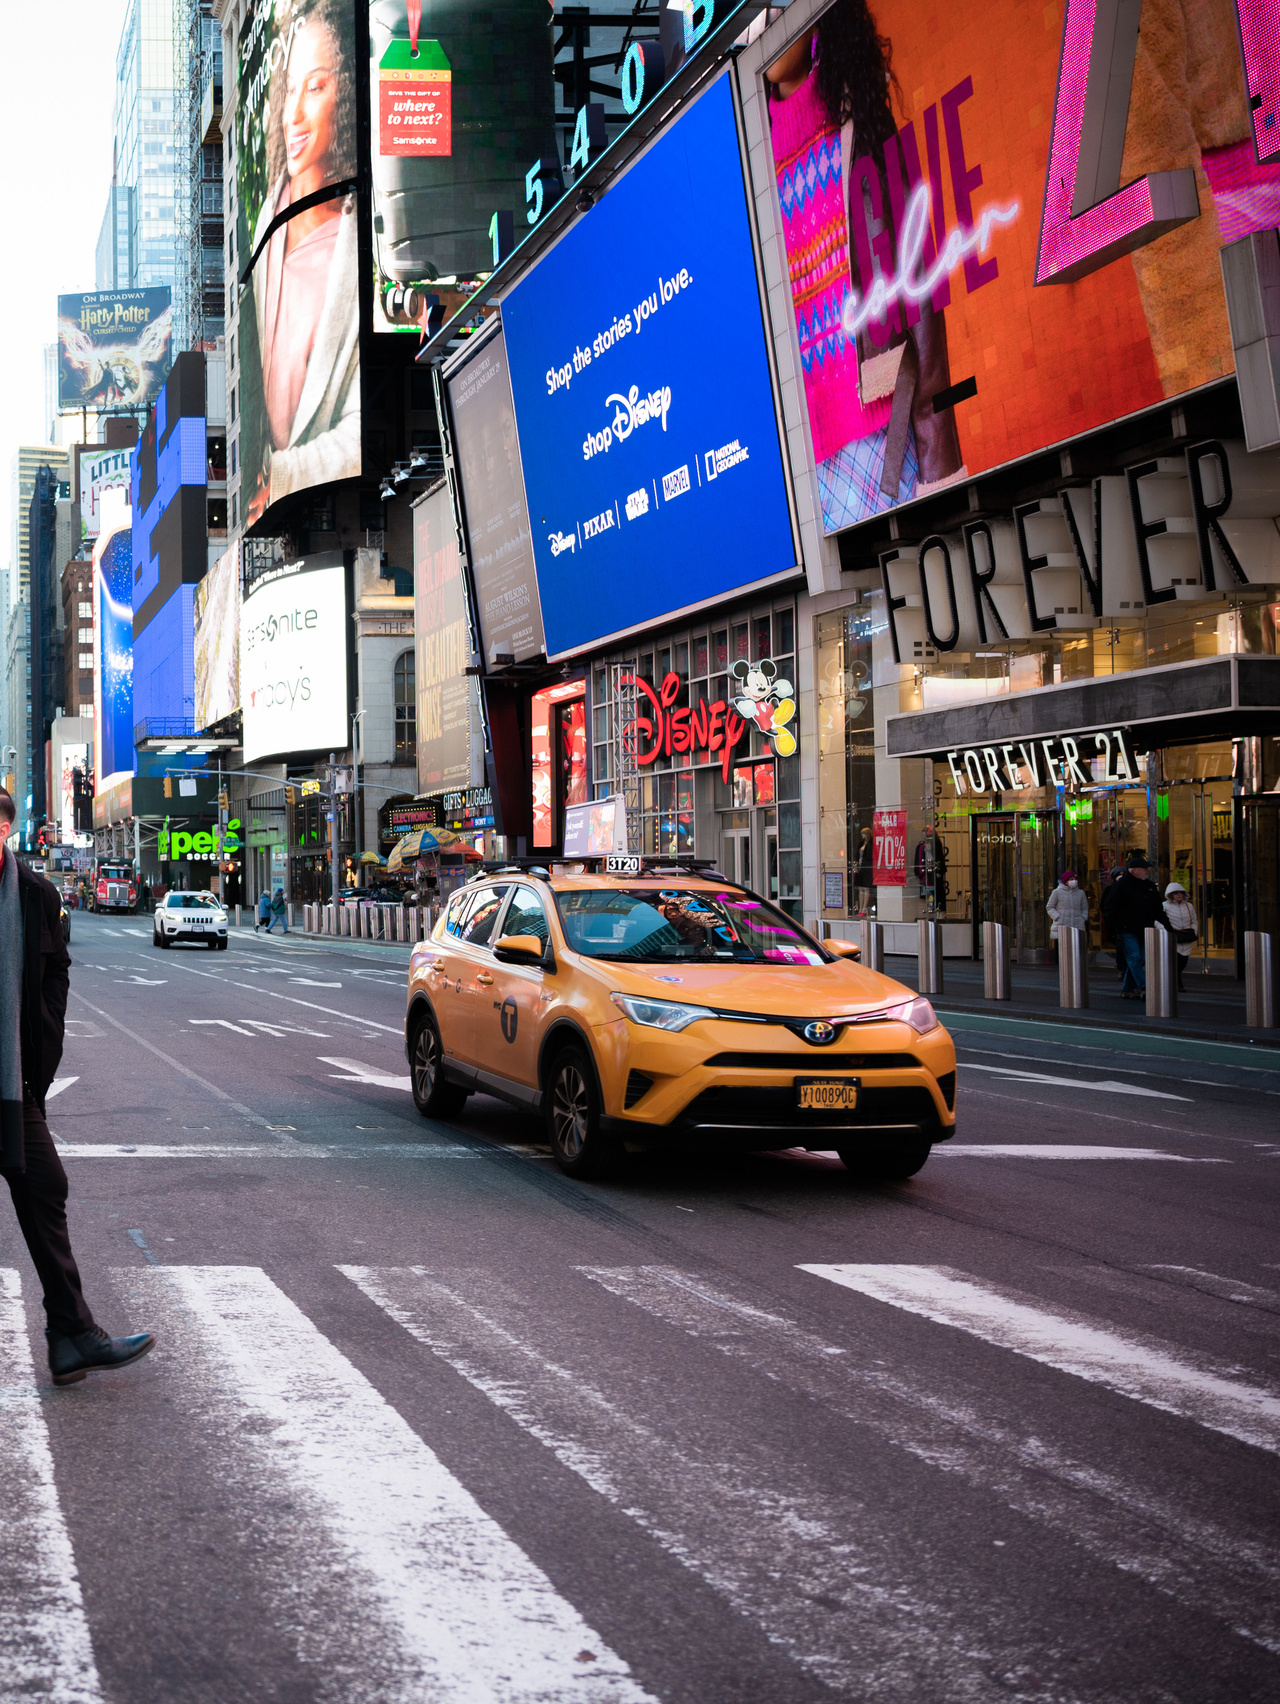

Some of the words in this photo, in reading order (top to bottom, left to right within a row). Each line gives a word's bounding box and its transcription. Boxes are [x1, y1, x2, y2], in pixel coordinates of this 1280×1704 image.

[393, 99, 436, 112] where
[388, 114, 401, 125] to
[404, 112, 443, 125] next?
[848, 75, 999, 348] GIVE
[842, 184, 1019, 333] color
[100, 292, 146, 302] BROADWAY
[79, 307, 113, 331] Harry
[114, 304, 150, 328] Potter
[546, 363, 573, 395] Shop
[573, 343, 592, 374] the
[593, 314, 632, 358] stories
[634, 292, 658, 334] you
[659, 268, 693, 304] love.
[460, 379, 468, 391] ON
[467, 356, 491, 387] BROADWAY
[455, 387, 476, 409] THROUGH
[475, 366, 496, 394] JANUARY
[583, 427, 612, 460] shop
[715, 439, 741, 462] NATIONAL
[717, 447, 750, 473] GEOGRAPHIC
[663, 466, 691, 501] MARVEL
[625, 497, 649, 521] WARS
[627, 488, 648, 508] STAR
[583, 509, 615, 540] PIXAR
[879, 440, 1248, 664] FOREVER
[947, 737, 1089, 795] FOREVER
[1095, 730, 1138, 782] 21
[443, 792, 462, 811] GIFTS
[393, 811, 434, 824] ELECTRONICS
[475, 818, 487, 826] SONY
[881, 815, 897, 826] SALE
[609, 858, 638, 870] 3T20
[876, 835, 905, 869] 70%
[895, 859, 905, 870] OFF
[493, 1001, 502, 1010] NYC
[802, 1087, 854, 1104] Y100890C
